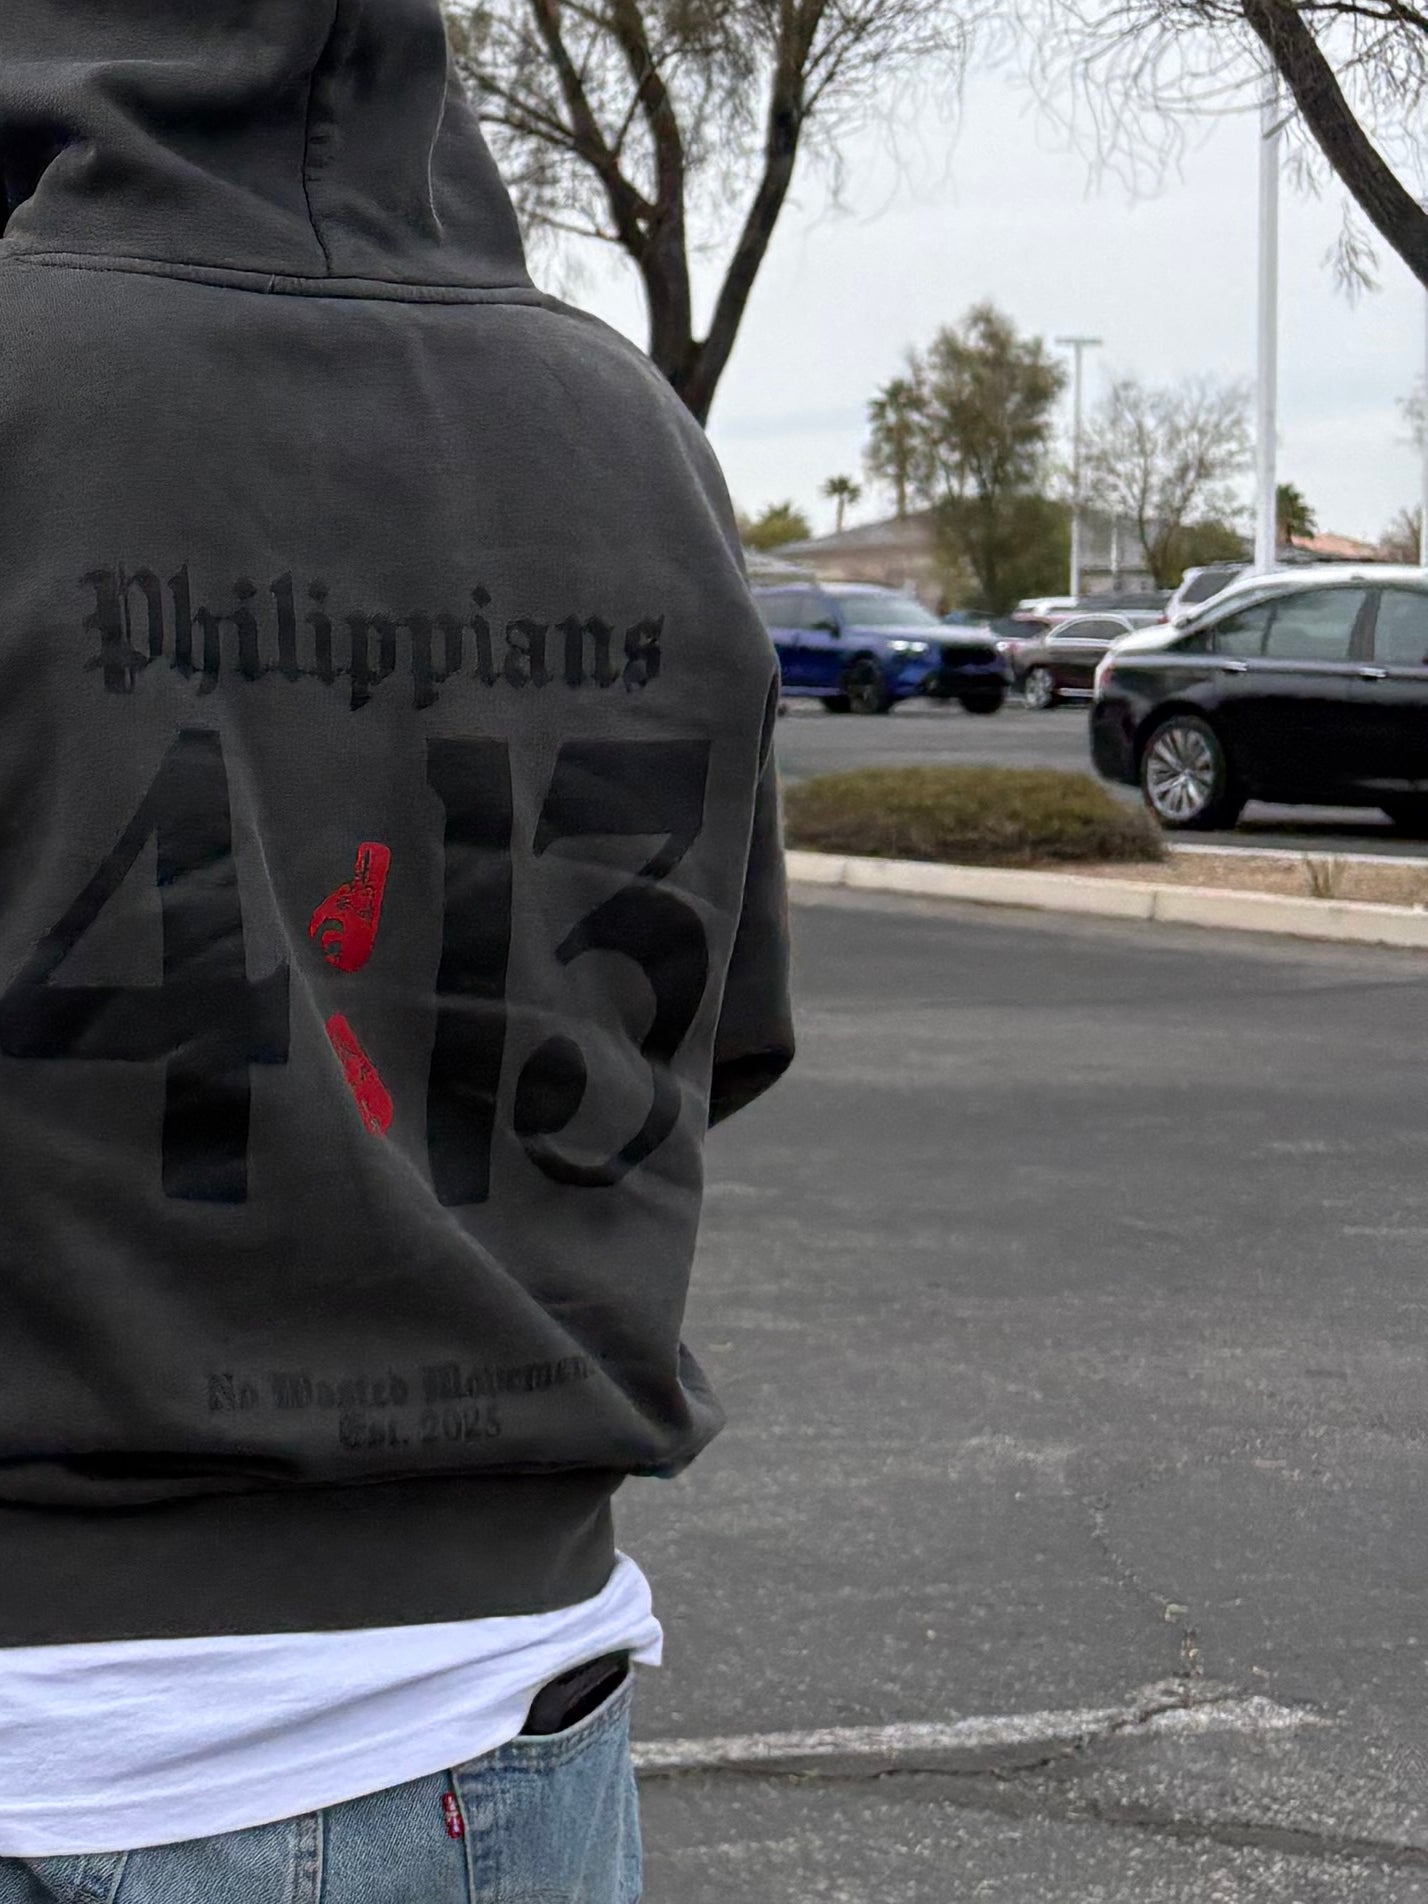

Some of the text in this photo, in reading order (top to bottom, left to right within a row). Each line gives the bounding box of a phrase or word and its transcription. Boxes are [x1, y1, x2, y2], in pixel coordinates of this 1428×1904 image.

[78, 562, 666, 713] Philippians
[208, 1370, 259, 1411] No
[272, 1365, 410, 1409] Wasted
[420, 1403, 502, 1444] 2025
